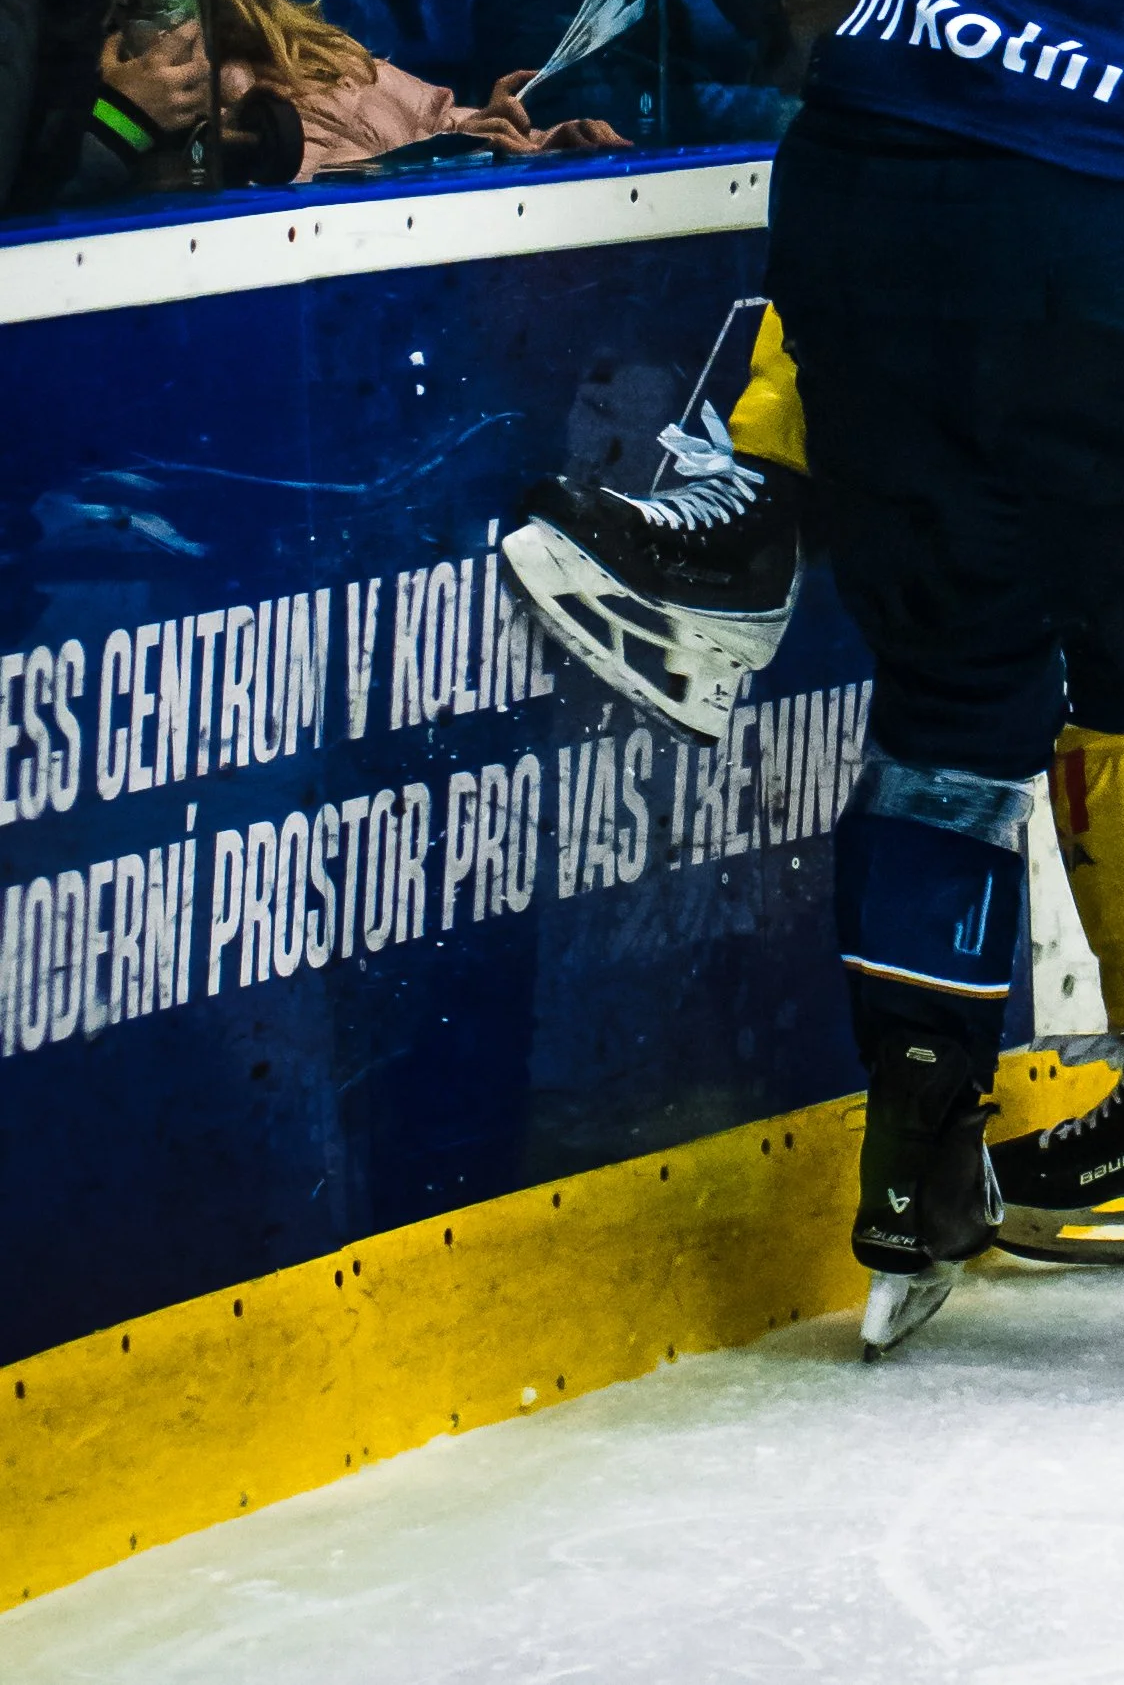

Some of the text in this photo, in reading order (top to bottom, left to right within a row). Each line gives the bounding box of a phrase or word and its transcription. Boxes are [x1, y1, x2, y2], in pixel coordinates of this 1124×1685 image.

[97, 589, 330, 800] CENTRUM
[346, 577, 382, 739] V
[208, 782, 431, 997] PROSTOR
[442, 754, 541, 931] PRO
